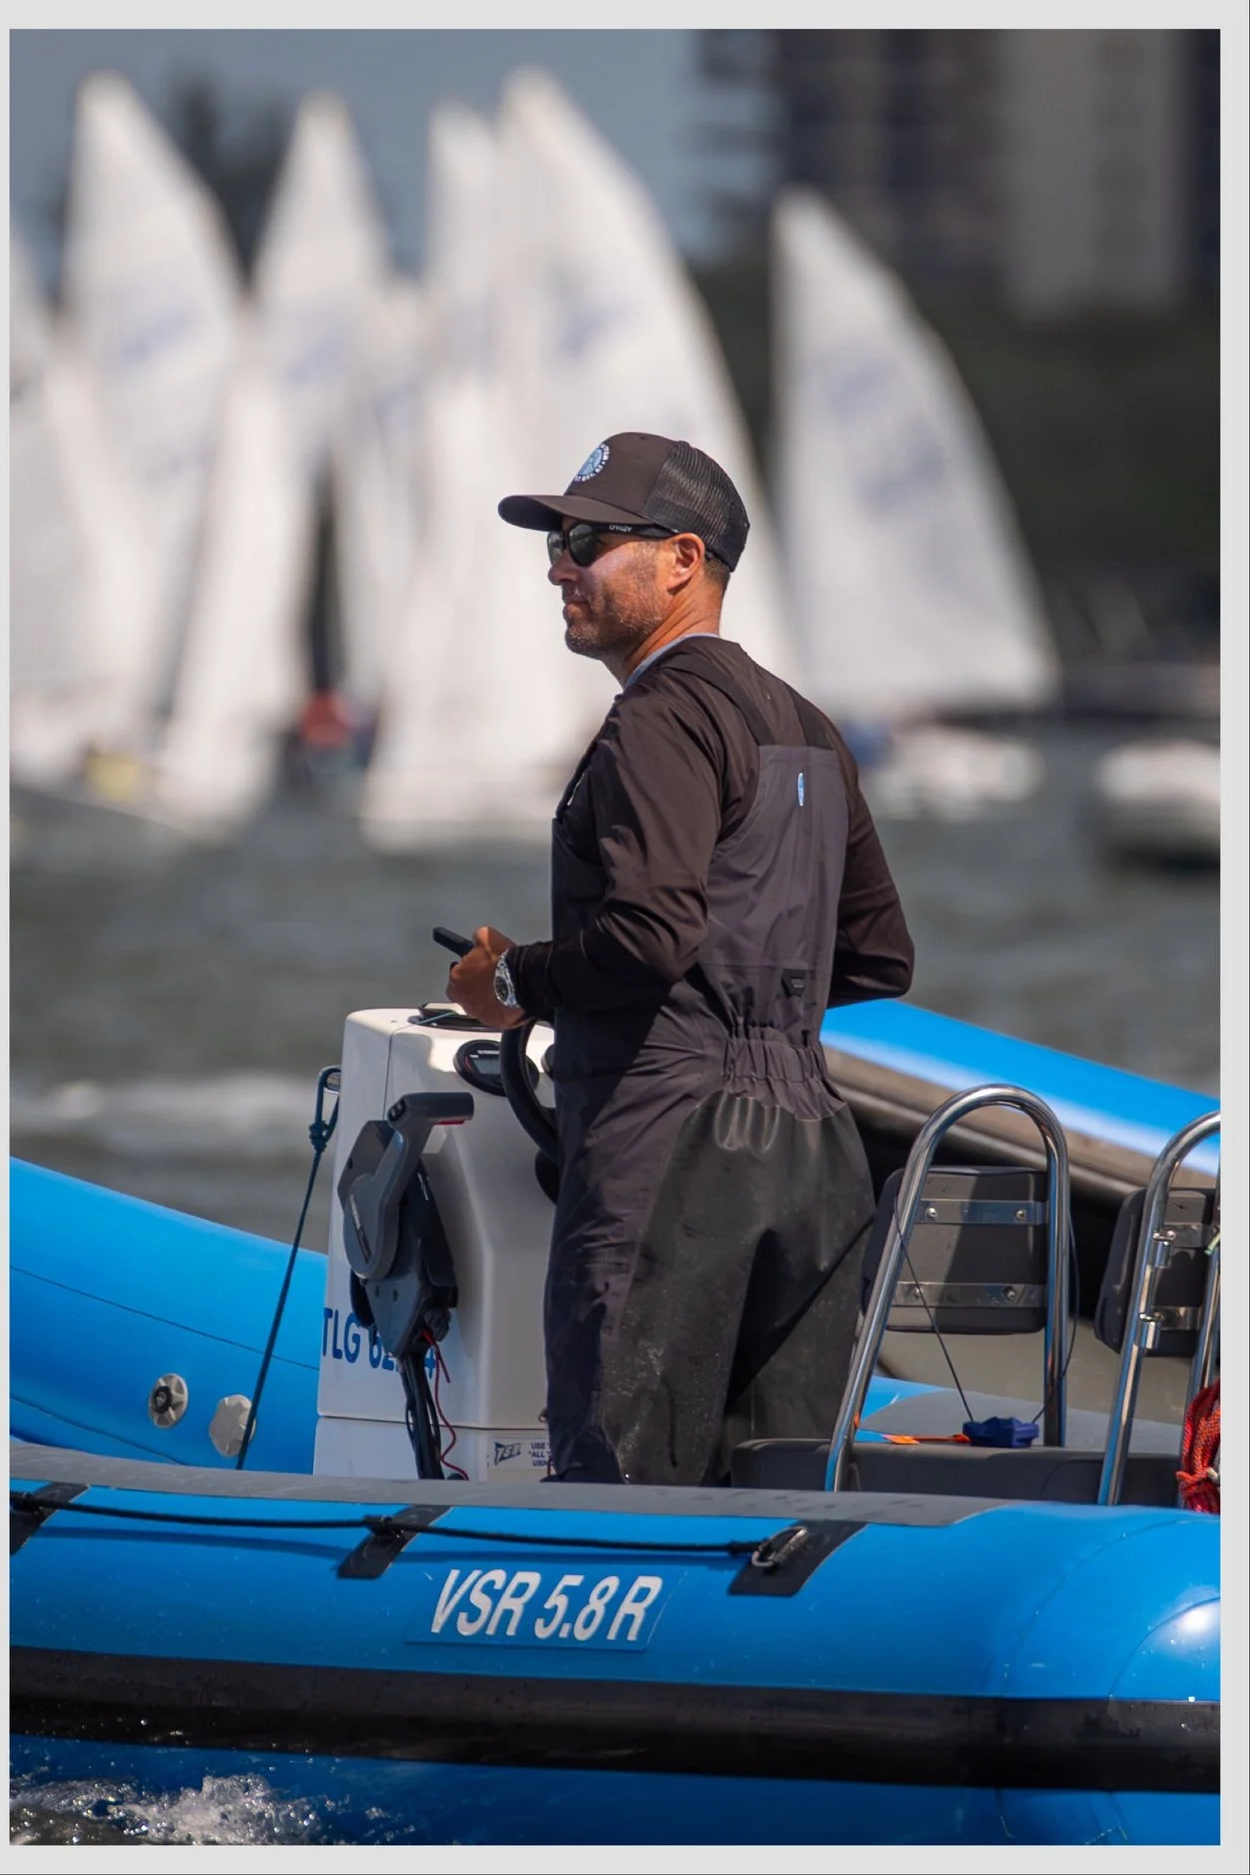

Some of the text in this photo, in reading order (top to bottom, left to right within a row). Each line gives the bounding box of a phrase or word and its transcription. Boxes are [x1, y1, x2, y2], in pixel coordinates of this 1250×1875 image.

[322, 1307, 361, 1364] TLG
[430, 1569, 663, 1641] VSR 5.8 R
